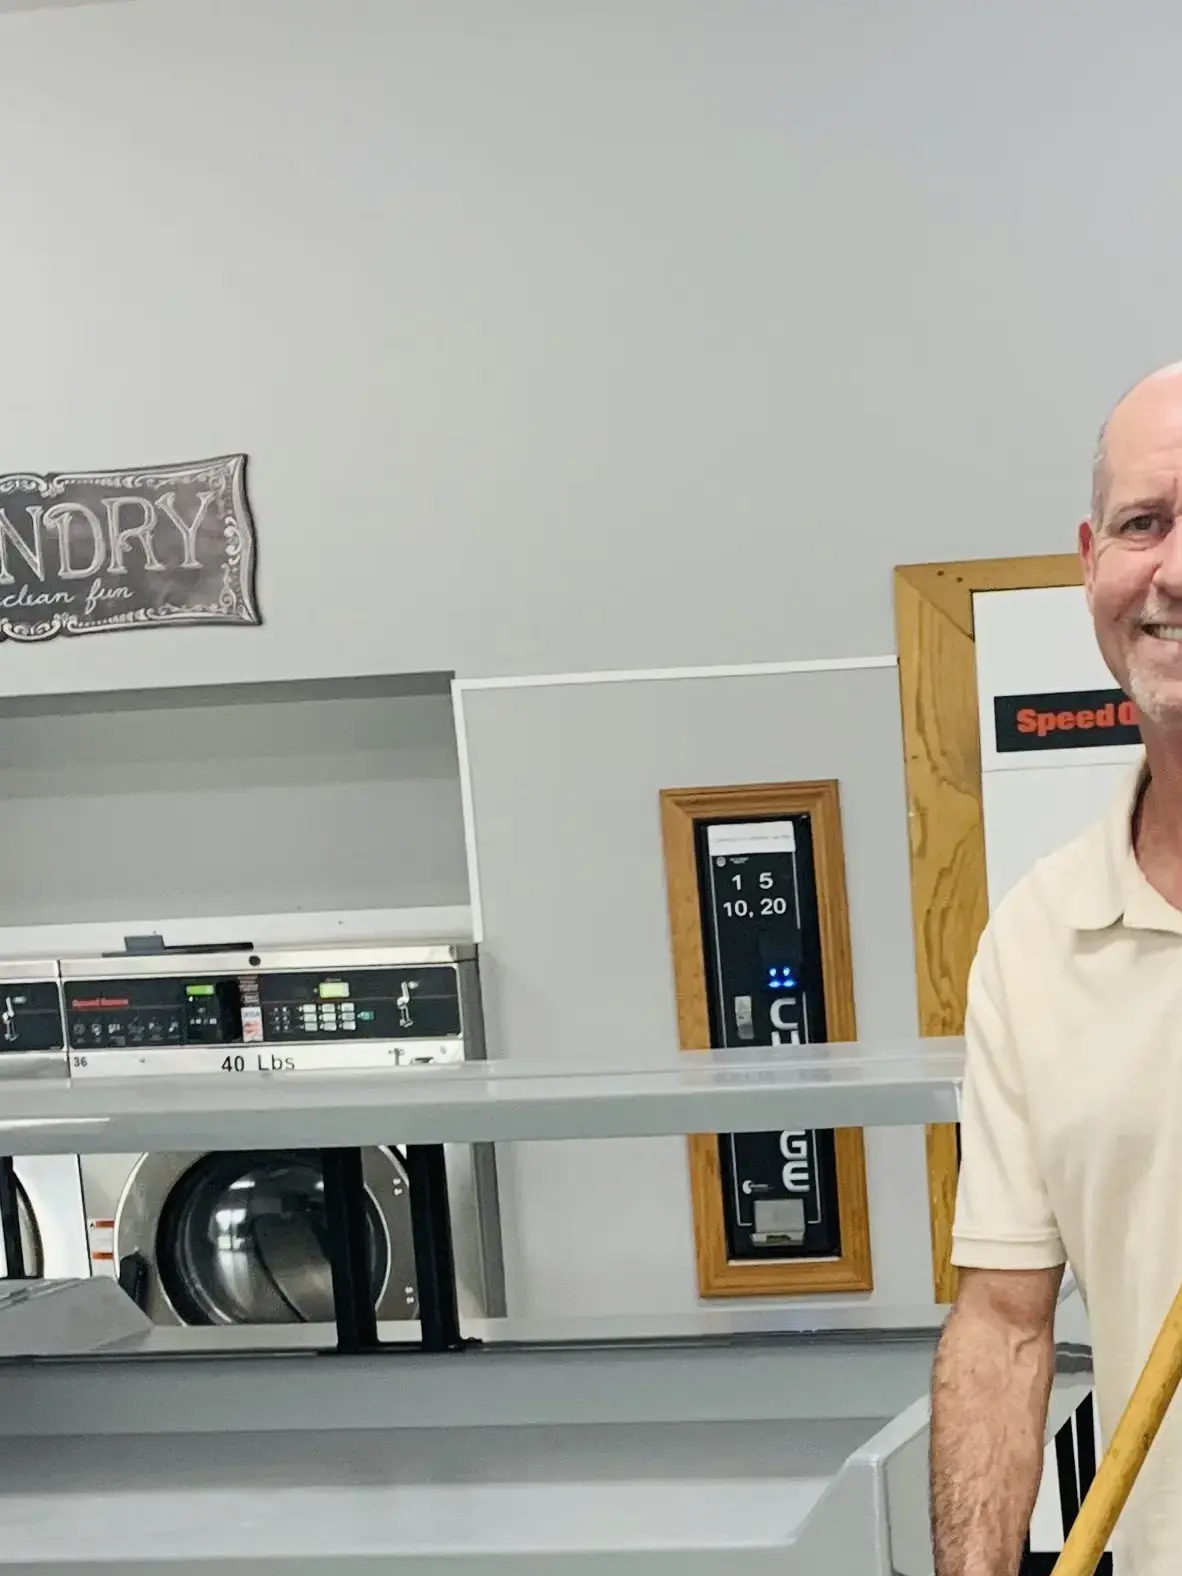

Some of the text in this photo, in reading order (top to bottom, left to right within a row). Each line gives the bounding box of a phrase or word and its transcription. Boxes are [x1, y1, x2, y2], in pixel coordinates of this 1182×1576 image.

[0, 491, 216, 584] NDRY
[1, 577, 135, 615] clean fun
[1016, 702, 1115, 737] Speed
[731, 871, 774, 891] 1 5
[723, 897, 787, 918] 10, 20
[73, 1056, 88, 1068] 36
[221, 1054, 295, 1072] 40 Lbs
